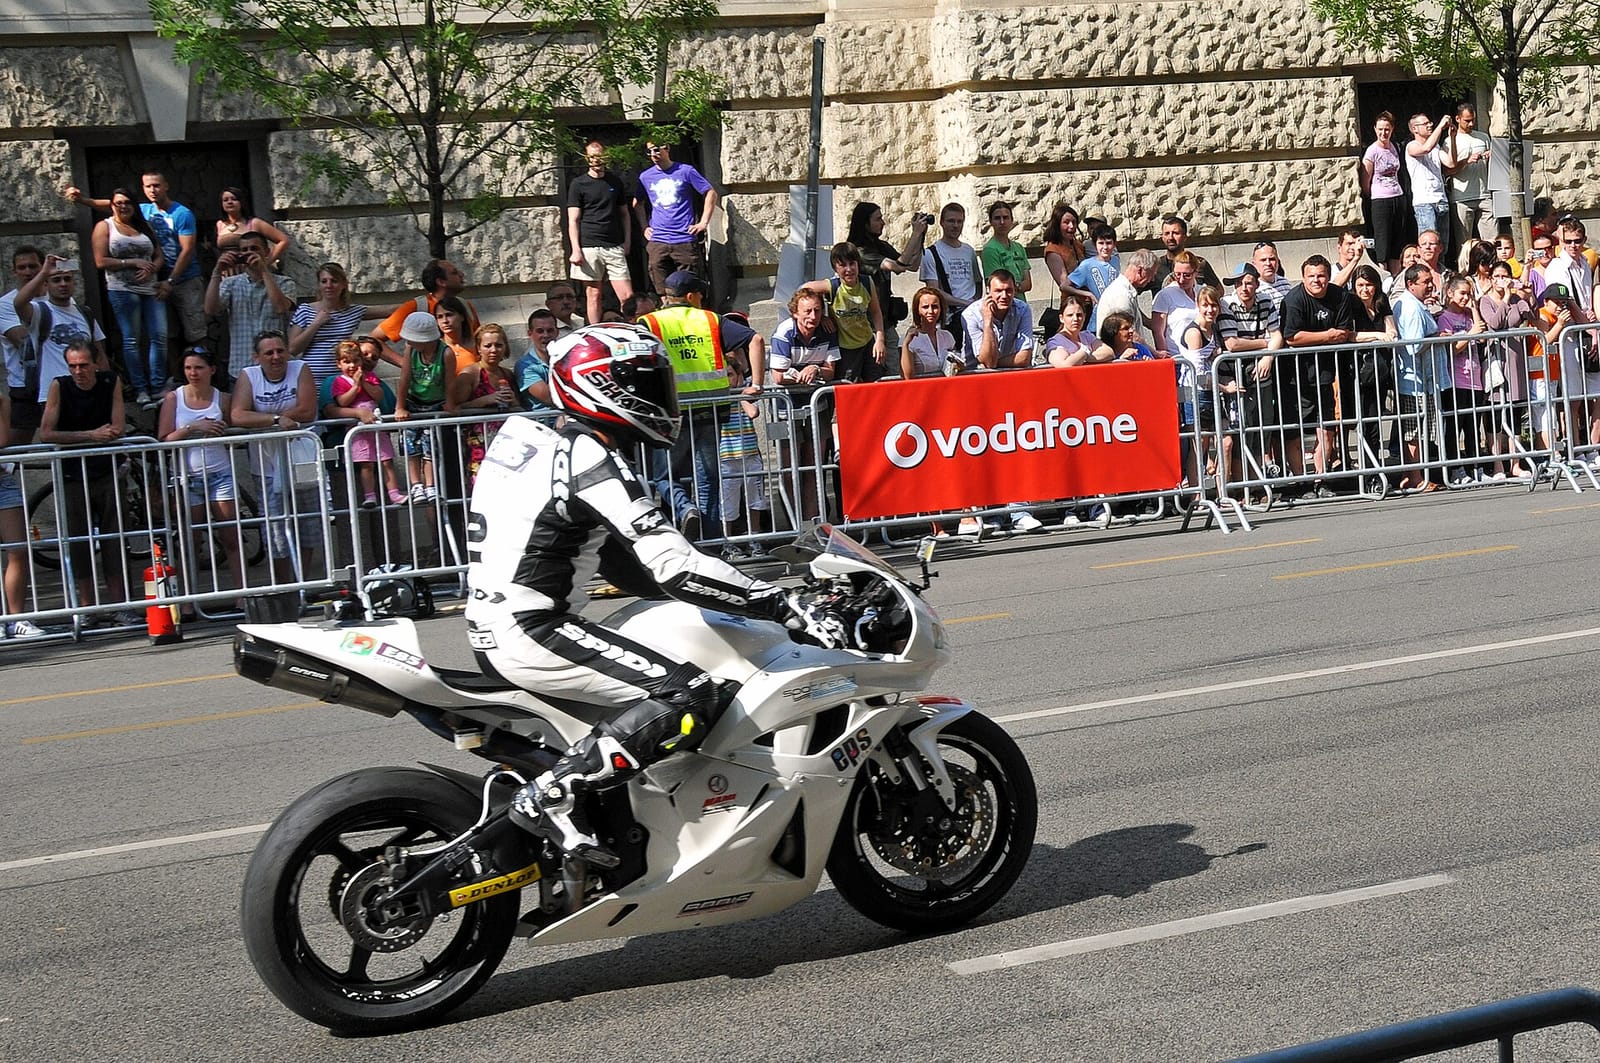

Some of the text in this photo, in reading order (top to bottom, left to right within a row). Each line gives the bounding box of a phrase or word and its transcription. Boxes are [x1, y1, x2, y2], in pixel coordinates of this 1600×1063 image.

[678, 348, 698, 360] 162
[931, 408, 1138, 458] vodafone
[554, 622, 668, 678] SPIDI
[831, 727, 872, 772] eps
[470, 868, 536, 898] DUNLOP
